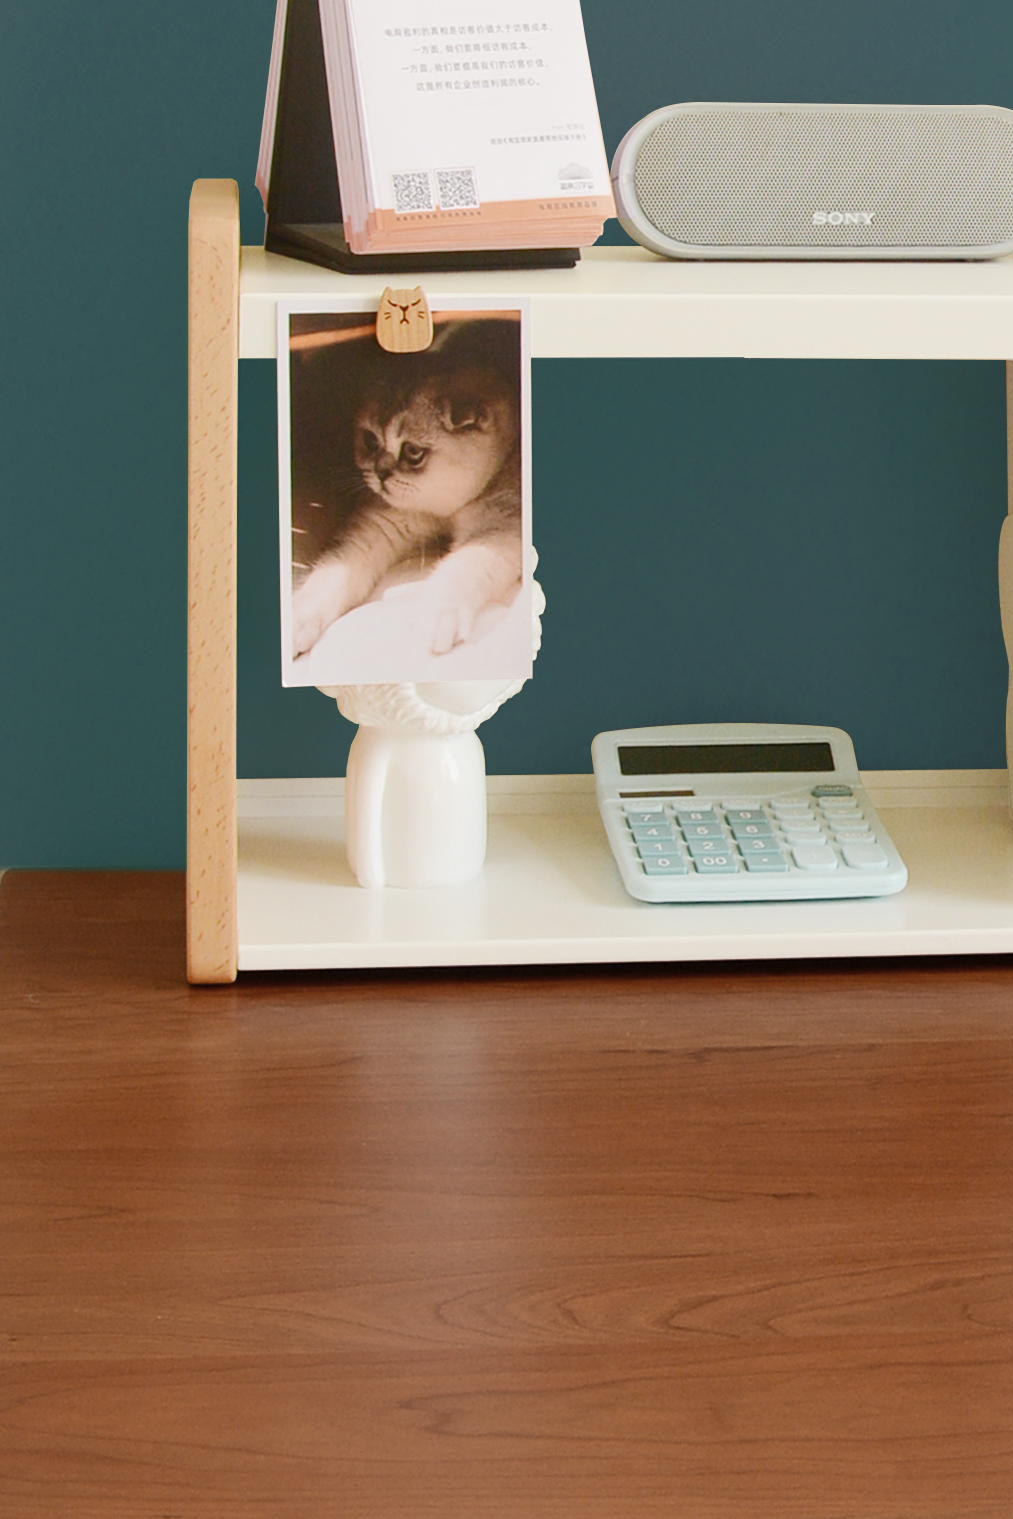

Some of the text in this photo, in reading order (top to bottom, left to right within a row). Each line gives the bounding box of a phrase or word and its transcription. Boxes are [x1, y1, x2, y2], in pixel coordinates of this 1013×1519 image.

[812, 211, 876, 226] SONY
[640, 811, 752, 822] 7 8 9
[646, 825, 758, 837] 4 5 6
[654, 839, 765, 852] 1 2 3
[657, 858, 670, 867] 0
[702, 856, 727, 866] 00
